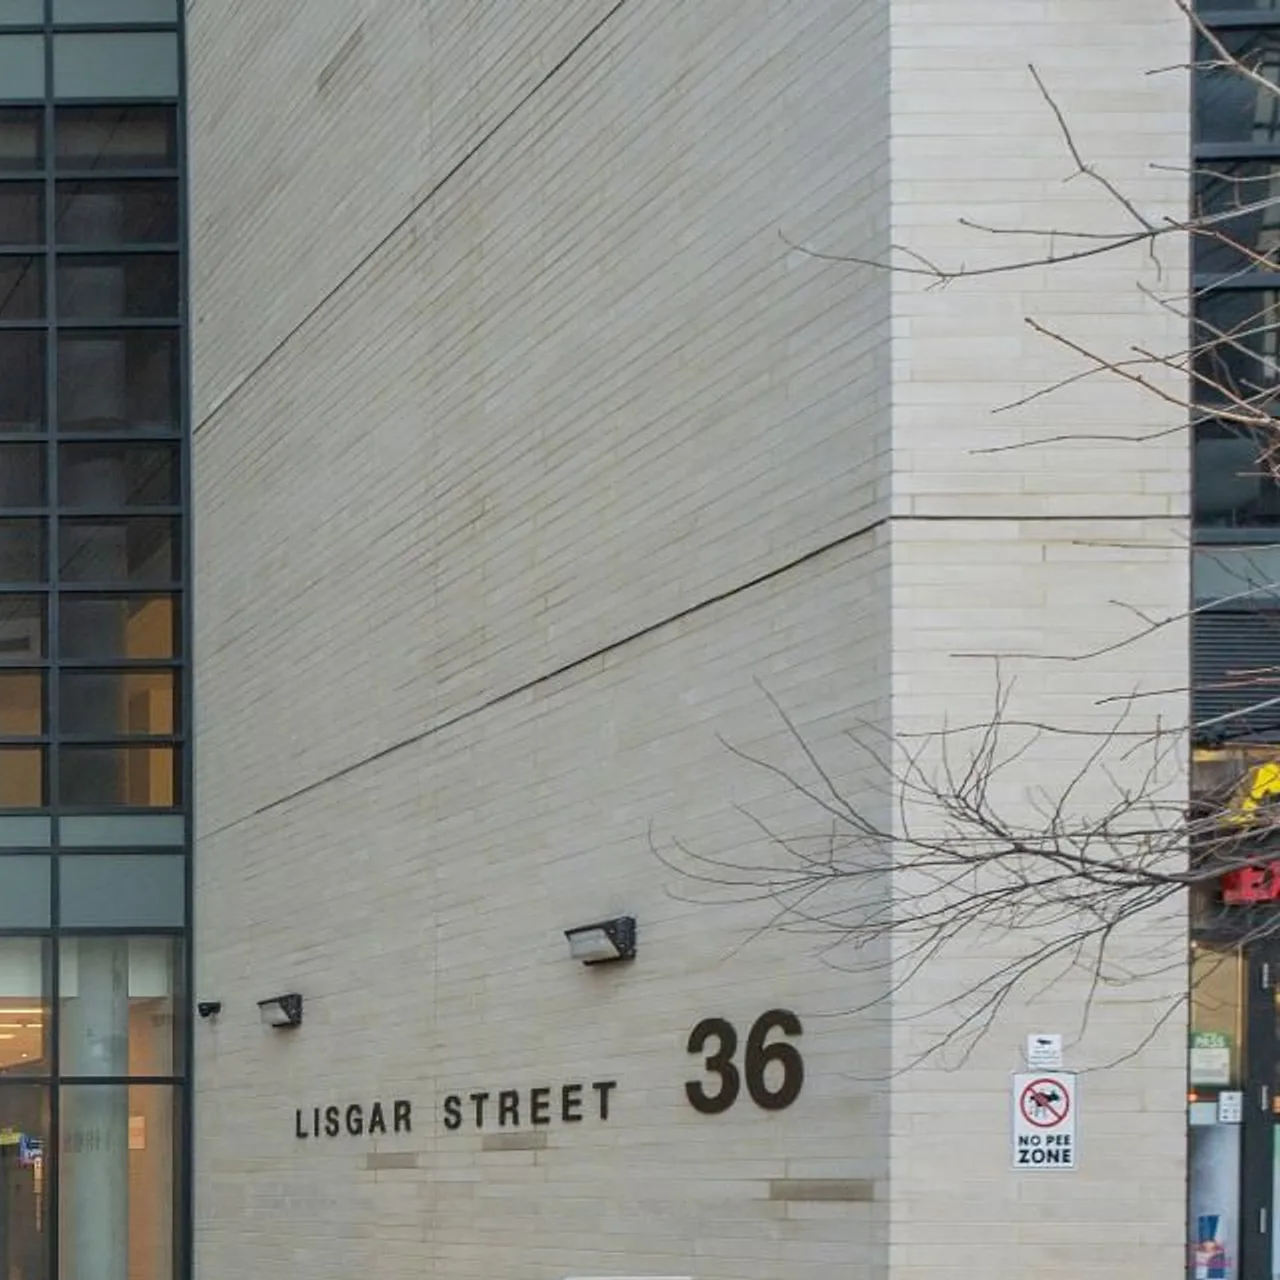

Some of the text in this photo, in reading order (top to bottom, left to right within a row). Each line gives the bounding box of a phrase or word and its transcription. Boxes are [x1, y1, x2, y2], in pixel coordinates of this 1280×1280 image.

[685, 1008, 804, 1115] 36
[295, 1081, 618, 1139] LISGAR STREET
[1018, 1134, 1071, 1146] NO PEE
[1018, 1149, 1071, 1163] ZONE
